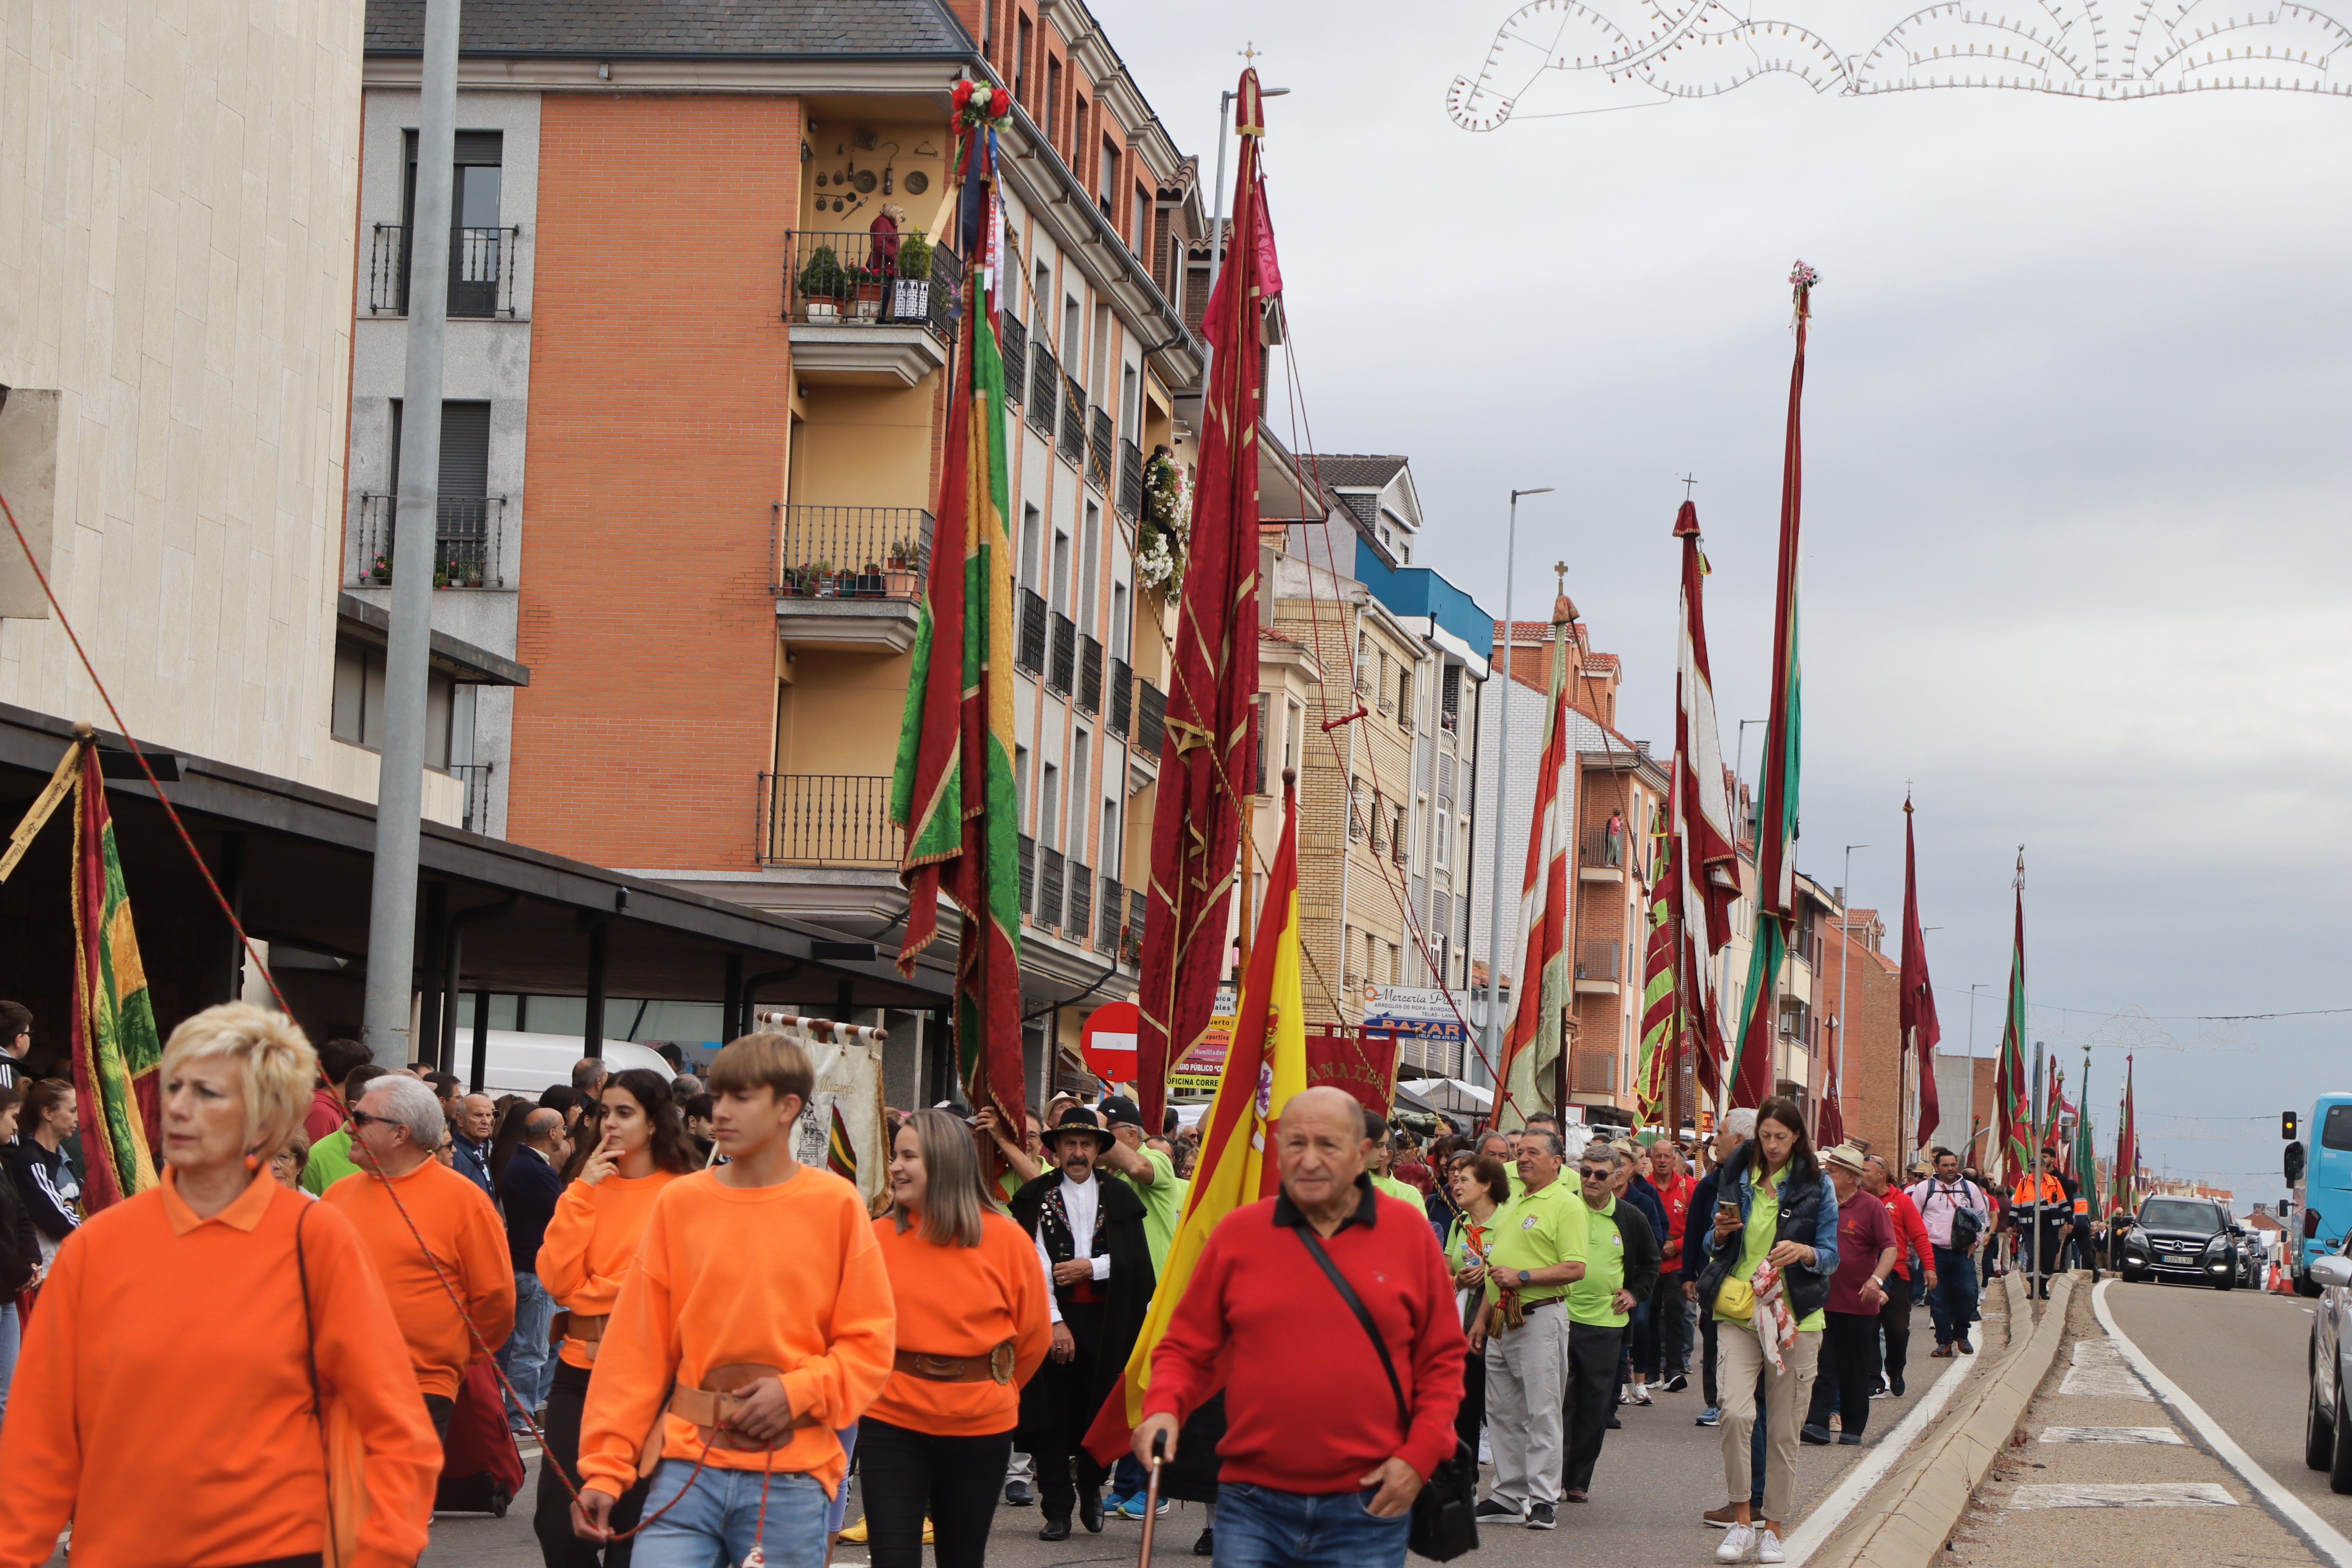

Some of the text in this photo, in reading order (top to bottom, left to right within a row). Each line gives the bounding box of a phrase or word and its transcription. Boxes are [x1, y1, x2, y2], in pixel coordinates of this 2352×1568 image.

[1430, 991, 1462, 1005] Pilar
[1382, 1020, 1460, 1036] BAZAR
[1190, 1062, 1213, 1072] PÚBLICO
[1167, 1077, 1219, 1087] OFICINA CORRE
